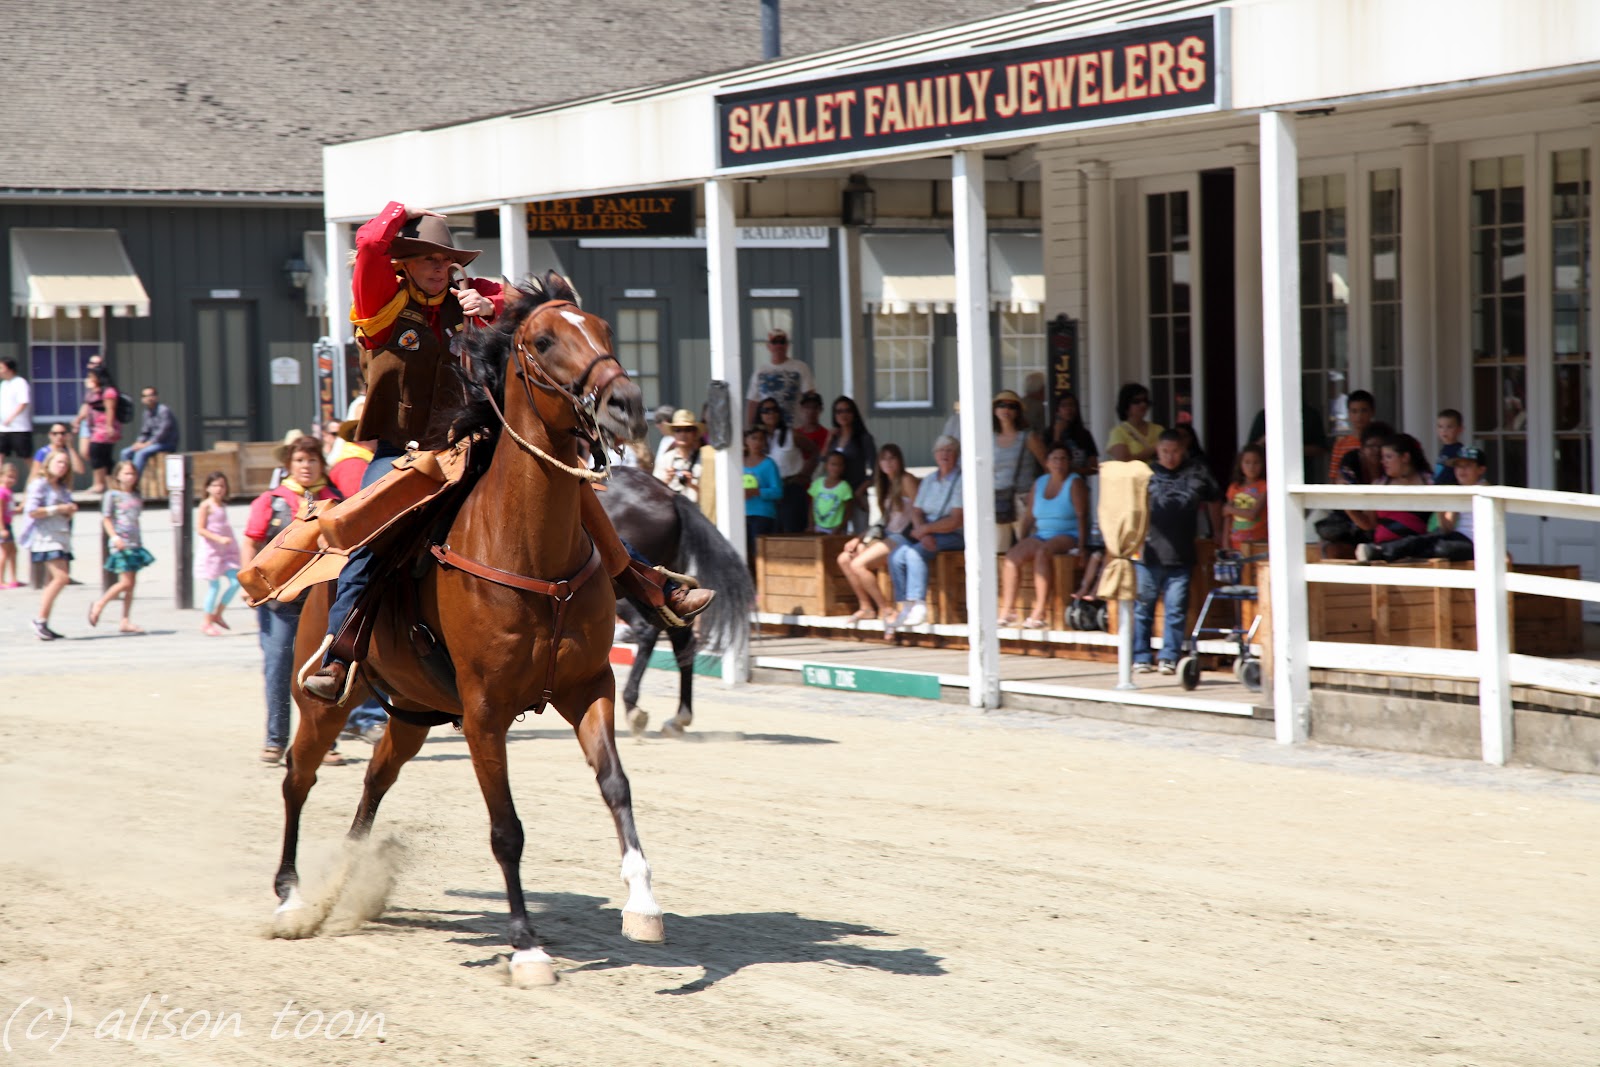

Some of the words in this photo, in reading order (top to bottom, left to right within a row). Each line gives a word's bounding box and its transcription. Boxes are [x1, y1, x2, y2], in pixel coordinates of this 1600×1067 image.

[728, 89, 857, 153] SKALET
[863, 68, 994, 137] FAMILY
[994, 36, 1206, 118] JEWELERS
[526, 199, 581, 214] ALET
[593, 197, 676, 214] FAMILY
[742, 225, 827, 240] RAILROAD
